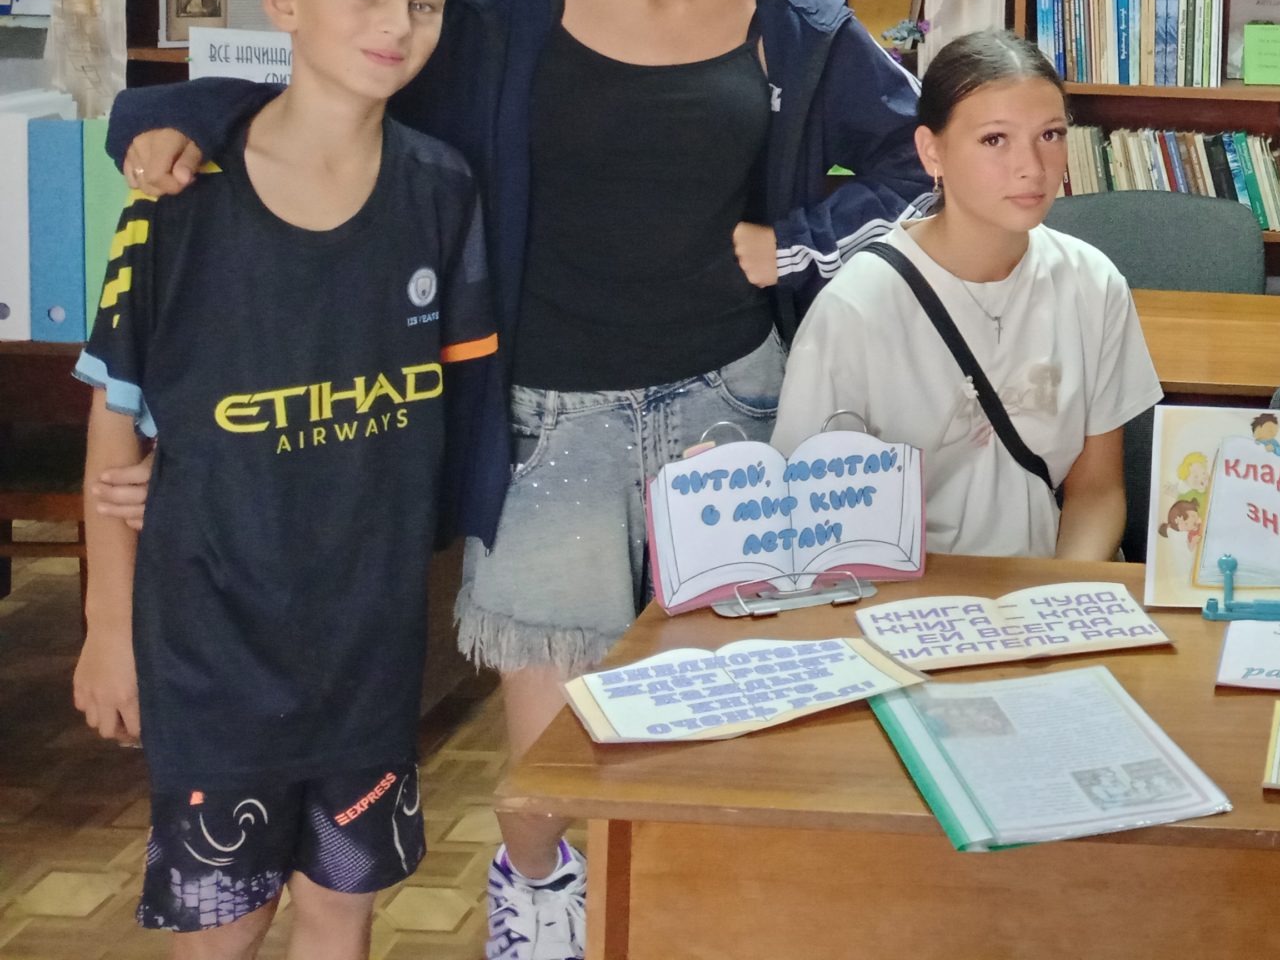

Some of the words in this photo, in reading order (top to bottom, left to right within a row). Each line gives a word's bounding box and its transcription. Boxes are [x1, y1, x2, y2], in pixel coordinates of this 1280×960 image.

[208, 43, 231, 64] ВСЕ
[214, 362, 443, 433] ETIHAD
[276, 409, 409, 454] AIRWAYS
[870, 604, 986, 625] КНИГА
[1030, 591, 1127, 607] ЧУДО,
[875, 616, 993, 637] КНИГА
[1038, 603, 1136, 620] КЛАД,
[917, 626, 965, 645] ЕЙ
[977, 616, 1113, 639] ВСЕГДА
[1080, 622, 1159, 641] РАД!
[345, 772, 397, 820] EXPRESS
